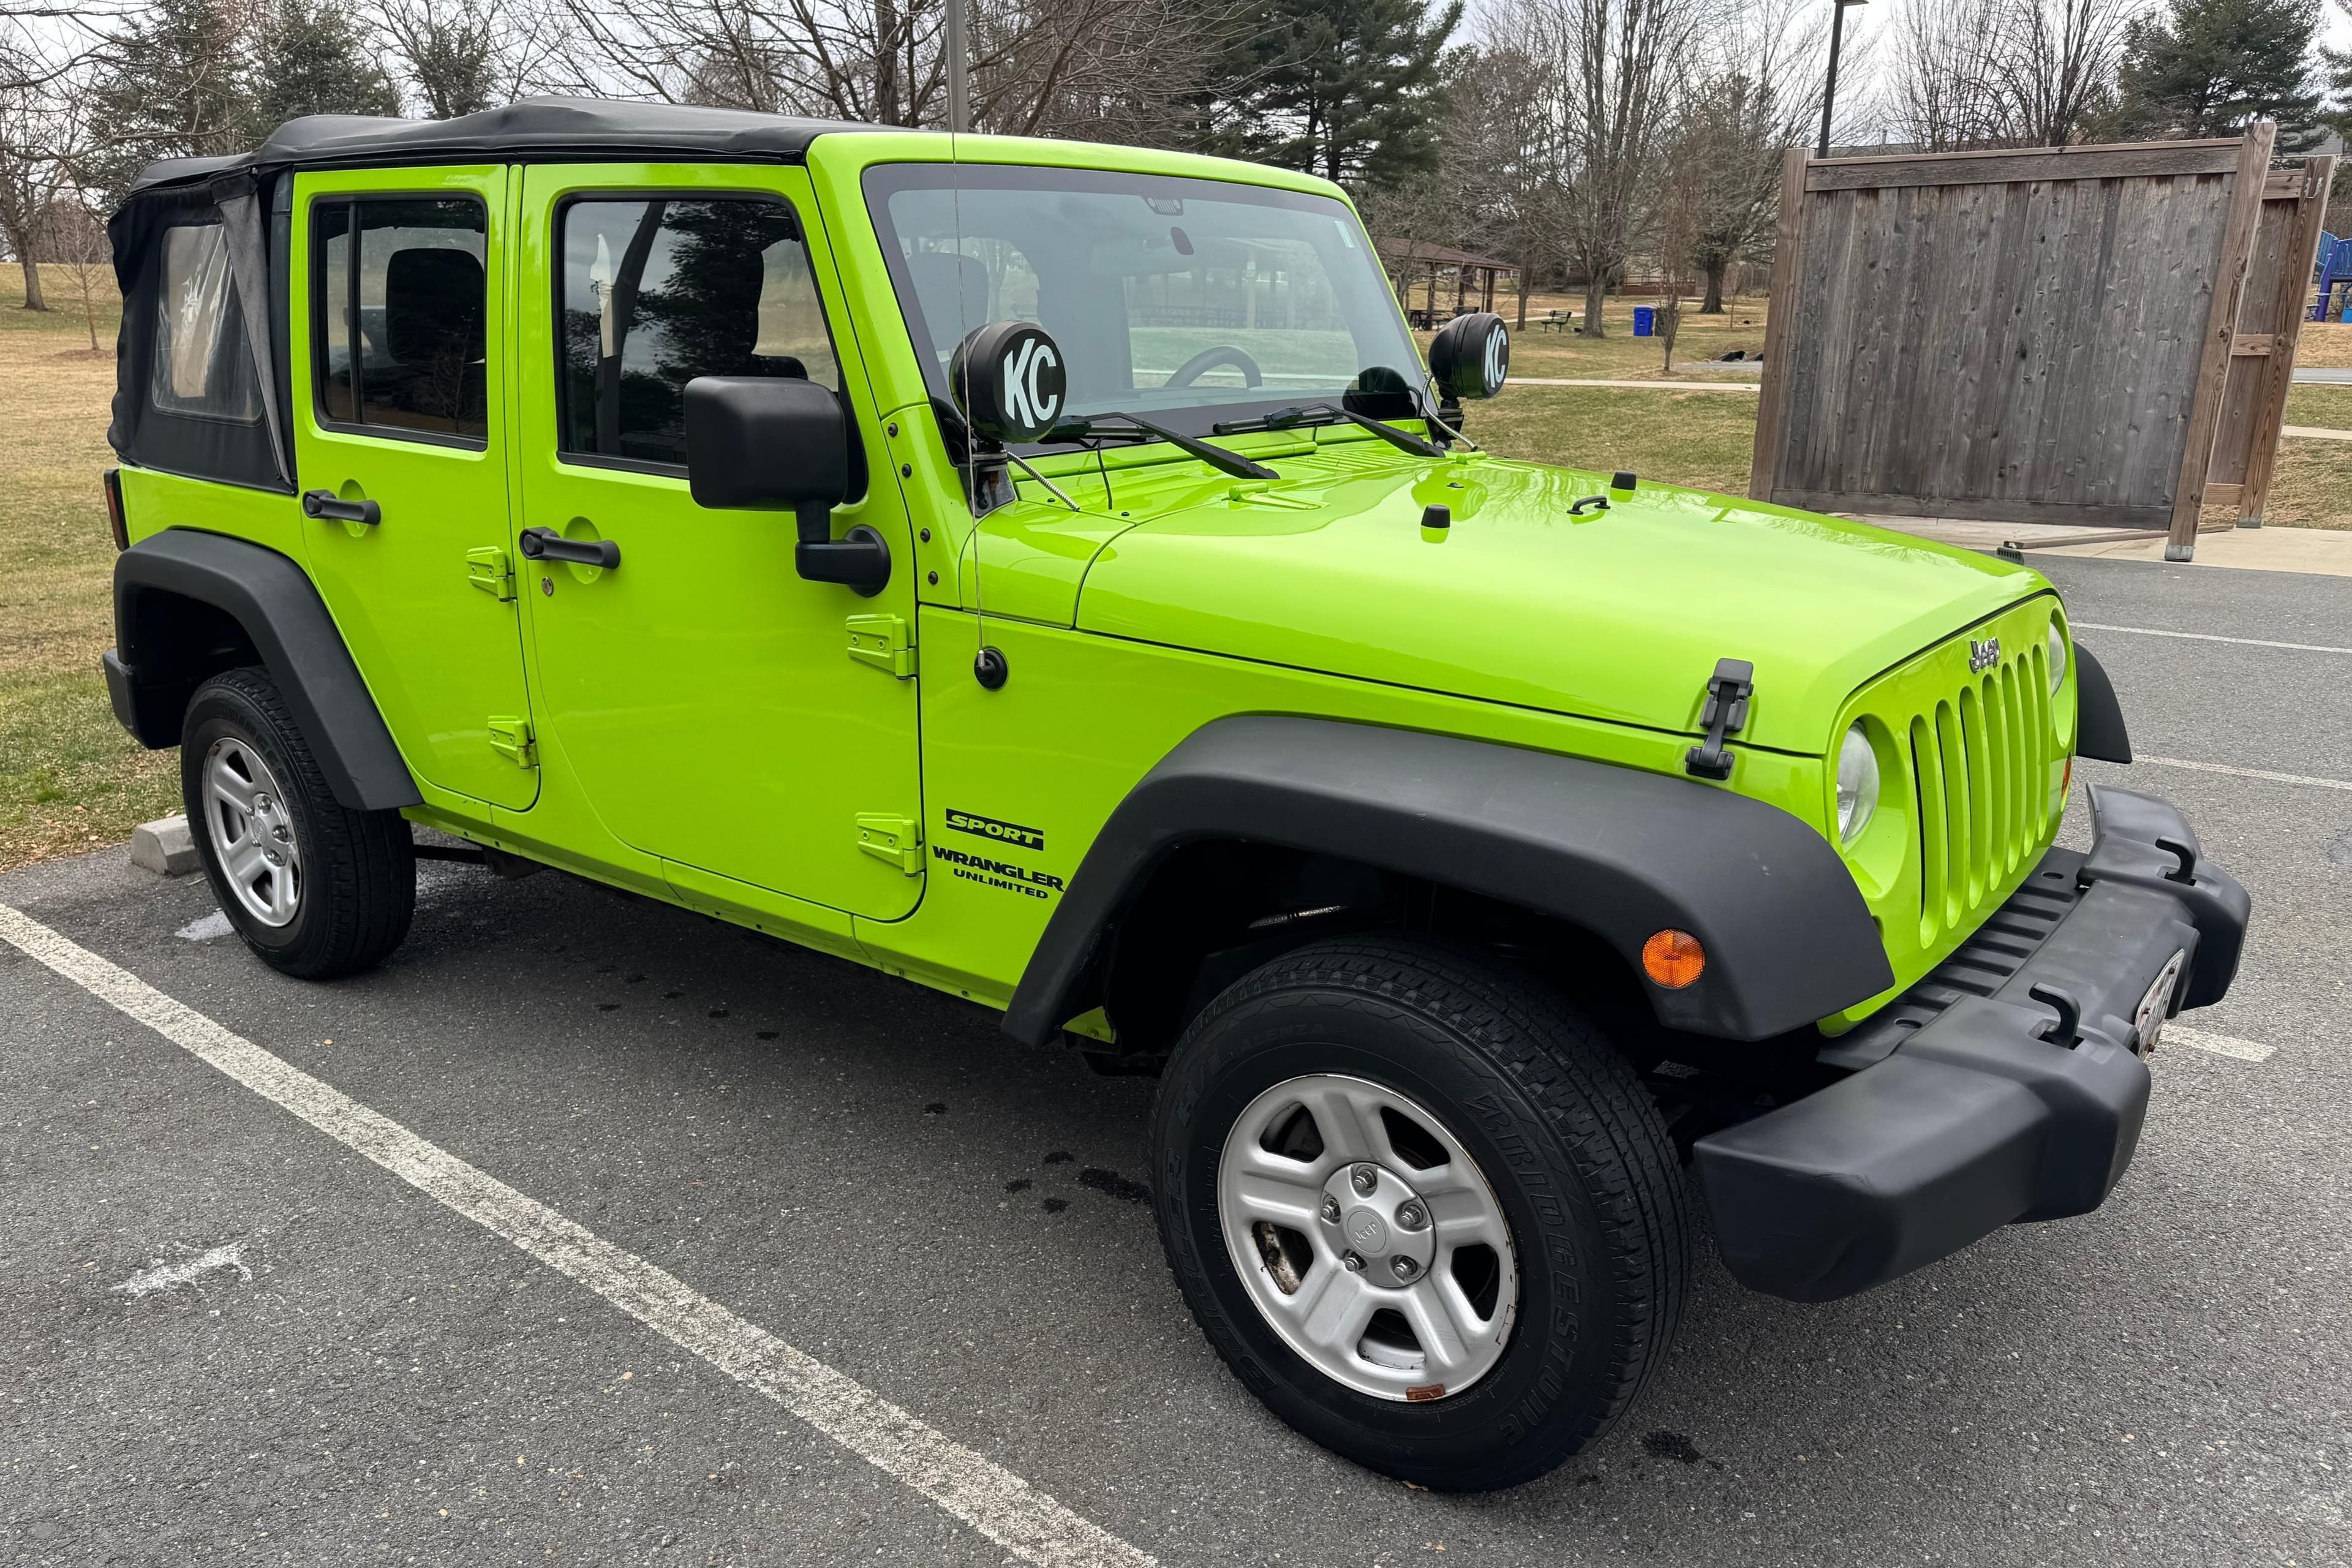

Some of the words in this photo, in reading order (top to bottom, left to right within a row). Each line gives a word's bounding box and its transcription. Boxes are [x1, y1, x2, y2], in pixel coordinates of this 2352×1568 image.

[1484, 324, 1507, 388] KC
[1003, 338, 1058, 429] KC
[1969, 636, 2000, 674] Jeep
[946, 813, 1044, 845] SPORT
[932, 845, 1065, 892] WRANGLER
[953, 868, 1049, 899] UNLIMITED
[1166, 1148, 1278, 1391] DUELER
[1240, 1023, 1326, 1055] ALENZA
[1354, 1221, 1378, 1243] Jeep
[1461, 1093, 1580, 1446] BRIDGESTONE
